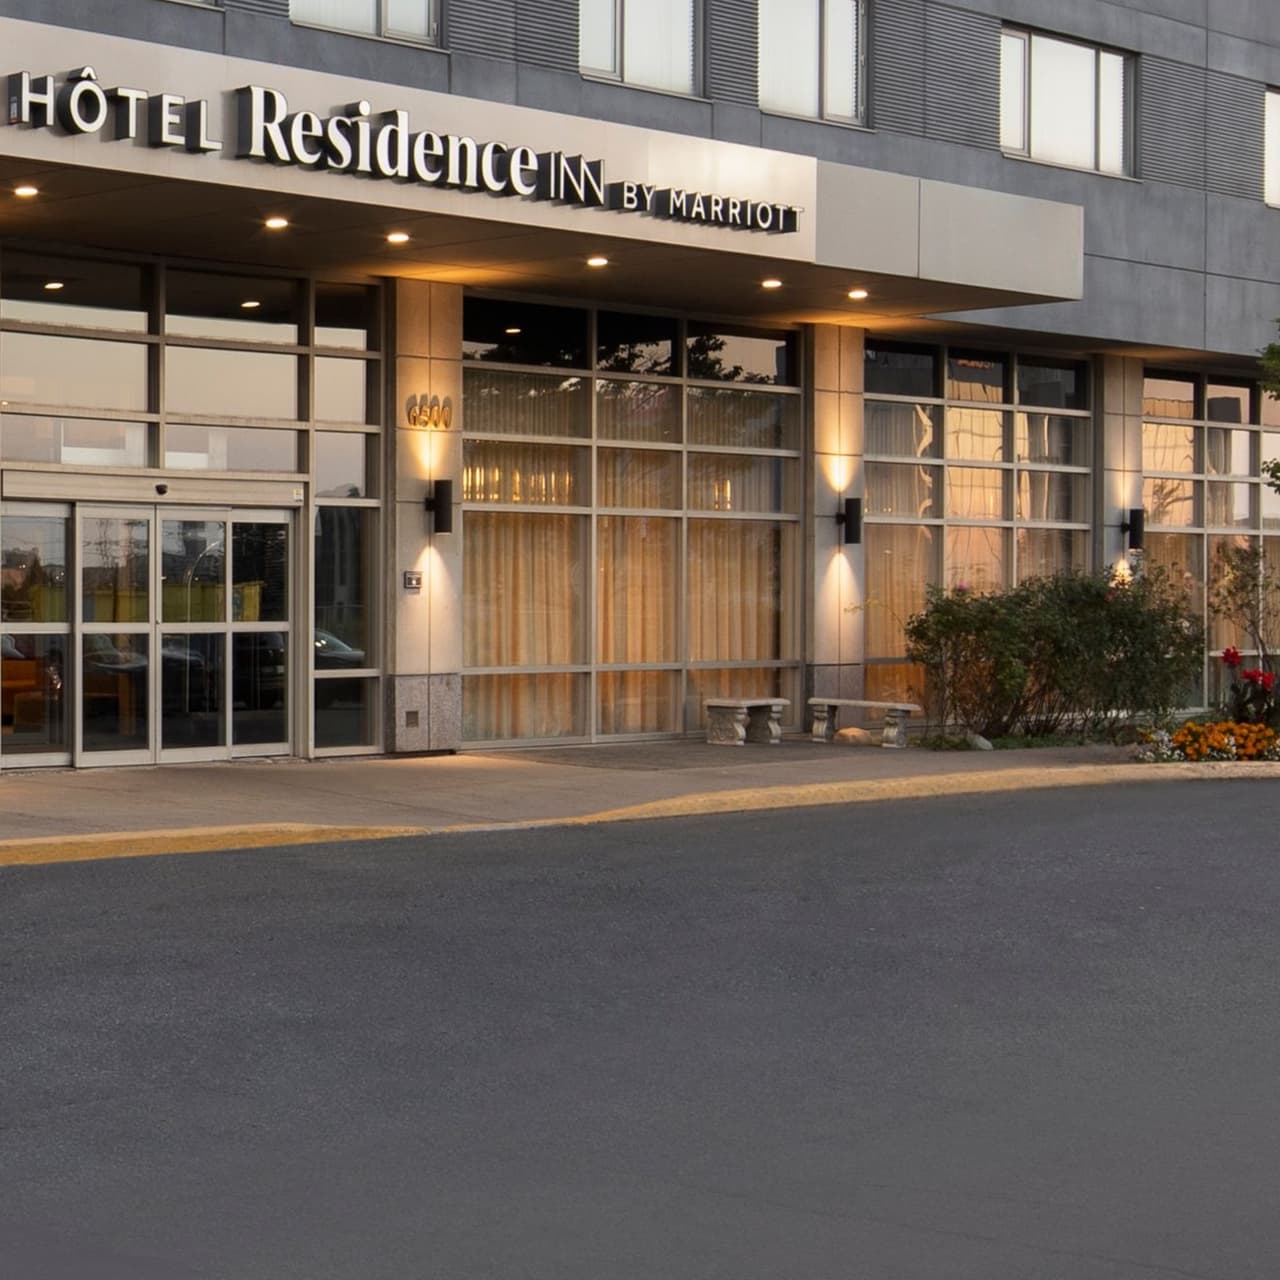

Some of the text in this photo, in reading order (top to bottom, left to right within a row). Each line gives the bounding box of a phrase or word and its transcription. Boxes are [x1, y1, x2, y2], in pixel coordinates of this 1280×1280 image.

[20, 65, 805, 233] HÔTEL Residence INN BY MARRIOTT
